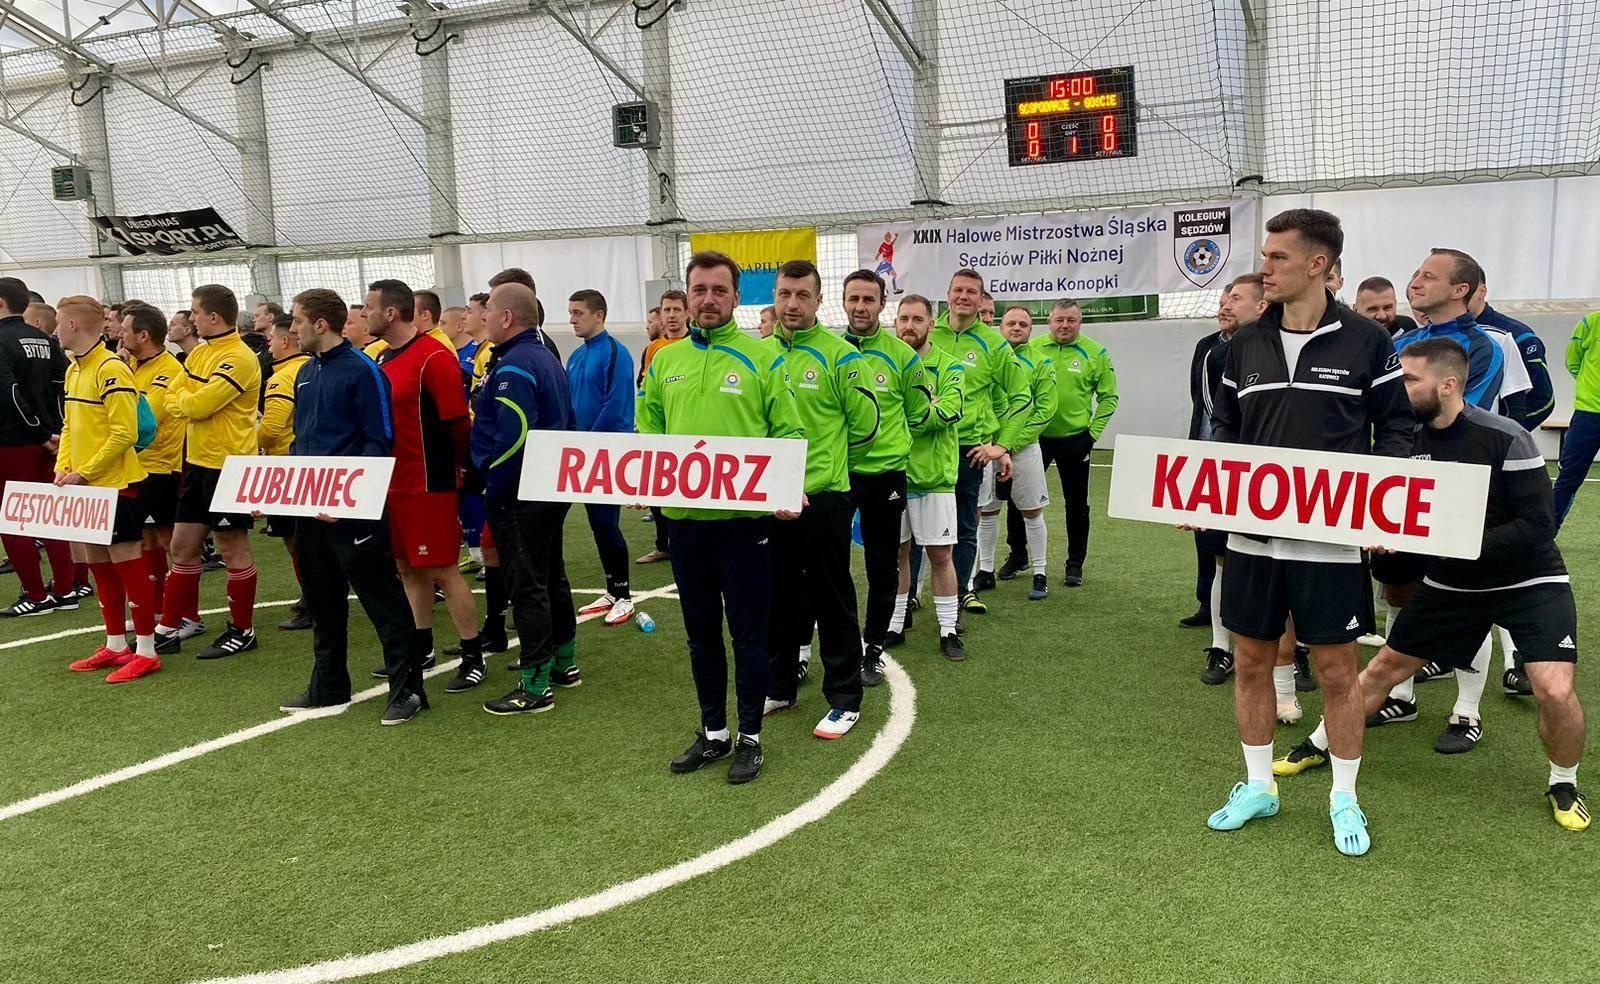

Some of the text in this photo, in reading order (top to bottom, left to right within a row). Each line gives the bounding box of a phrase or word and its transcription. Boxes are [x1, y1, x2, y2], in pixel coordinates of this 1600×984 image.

[1050, 77, 1093, 98] 15:00
[1072, 136, 1077, 153] 1
[1178, 210, 1226, 223] KOLEGIUM
[913, 215, 1167, 244] XXIX Halowe Mistrzostwa Śląska
[1180, 223, 1224, 237] SĘDZIÓW
[959, 245, 1124, 270] Sędziów Piłki Nożnej
[990, 274, 1119, 293] Edwarda Konopki
[556, 439, 772, 501] RACIBÓRZ
[235, 467, 365, 507] LUBLINIEC
[1151, 454, 1436, 537] KATOWICE
[5, 491, 109, 531] CZĘSTOCHOWA
